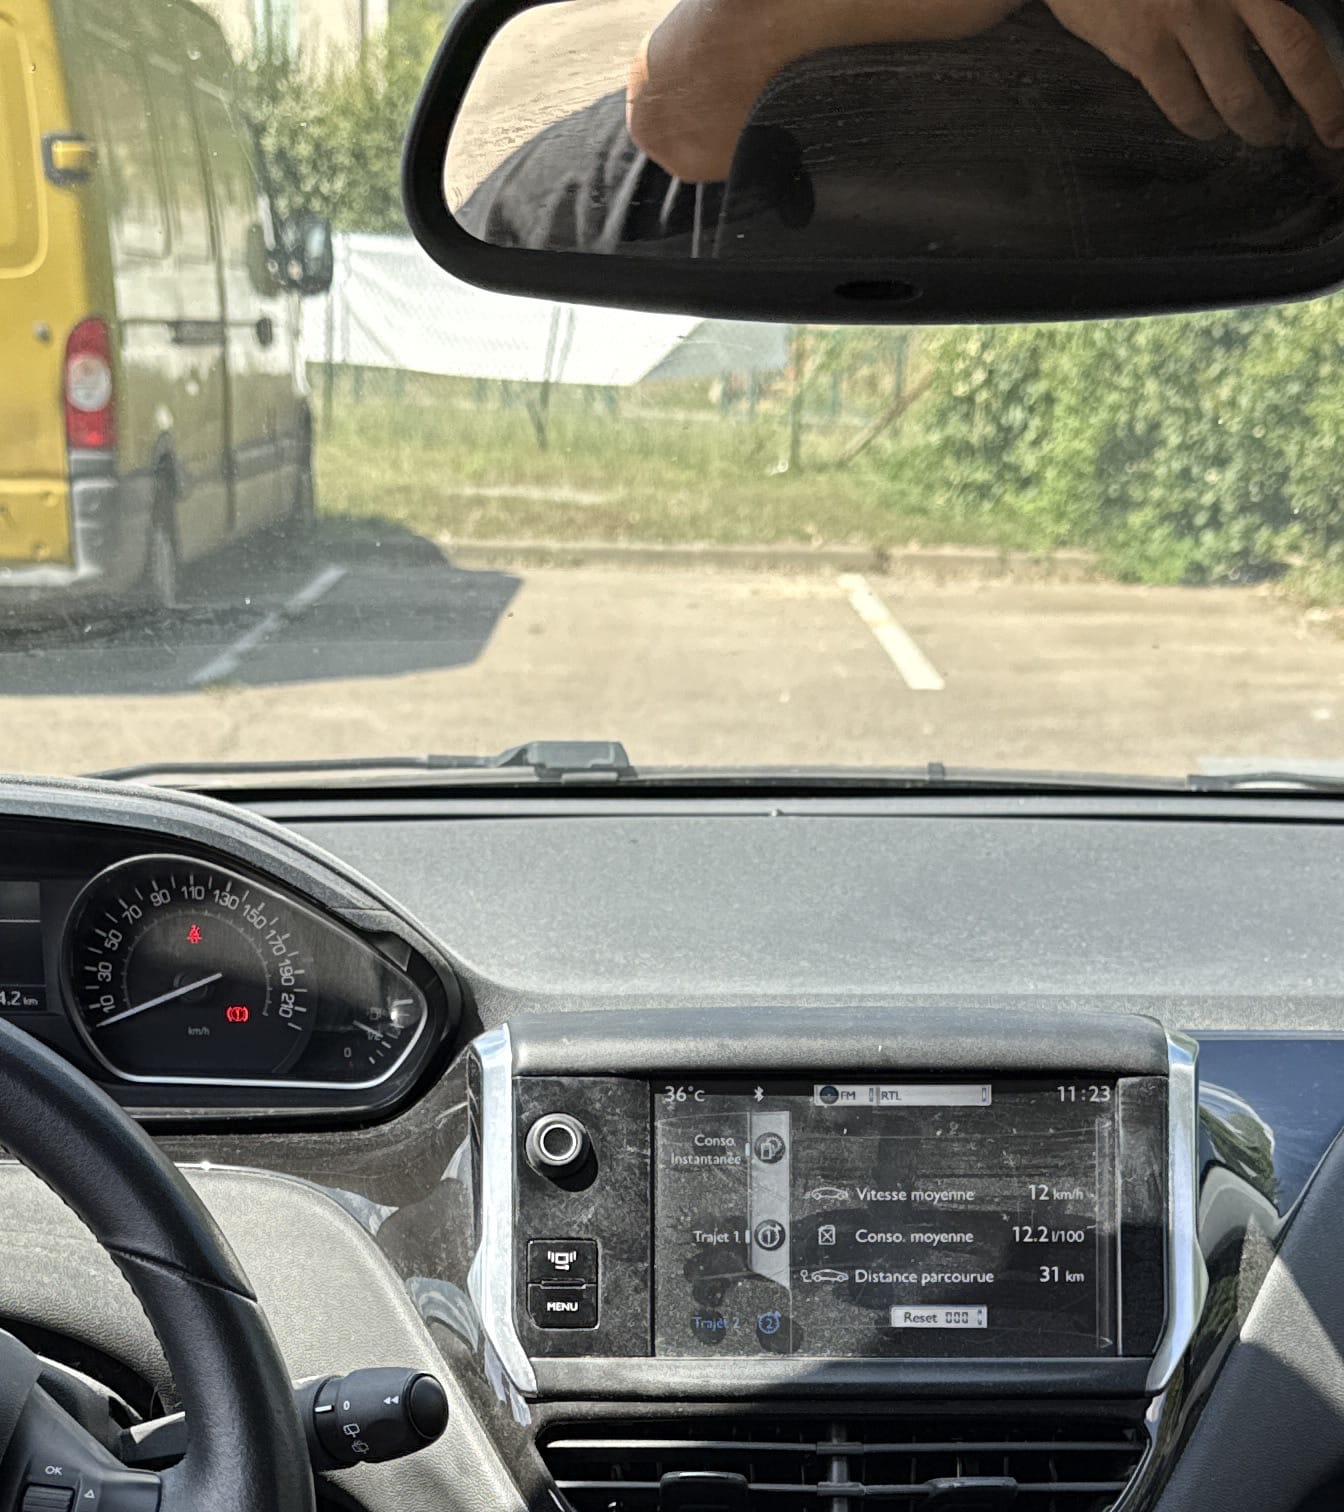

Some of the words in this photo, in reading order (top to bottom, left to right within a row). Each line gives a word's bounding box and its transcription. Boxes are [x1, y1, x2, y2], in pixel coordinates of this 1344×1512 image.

[150, 889, 171, 907] 90
[181, 886, 205, 900] 110
[213, 889, 239, 909] 130
[122, 904, 143, 924] 70
[242, 904, 267, 930] 150
[105, 929, 123, 950] 50
[265, 929, 286, 956] 170
[97, 961, 113, 982] 30
[278, 959, 295, 986] 190
[23, 997, 39, 1006] km
[99, 994, 116, 1013] 10
[278, 993, 296, 1019] 210
[187, 1026, 210, 1037] km/h
[840, 1090, 856, 1101] FM
[880, 1090, 902, 1101] RTL
[1056, 1085, 1111, 1103] 11:23
[855, 1187, 906, 1202] Vitesse
[911, 1190, 976, 1205] moyenne
[1028, 1184, 1050, 1201] 12
[1053, 1187, 1084, 1201] km/h
[692, 1230, 730, 1246] Trajet
[855, 1228, 906, 1243] Conso.
[910, 1232, 975, 1247] moyenne
[1012, 1226, 1049, 1243] 12.2
[854, 1269, 918, 1284] Distance
[921, 1273, 995, 1287] parcourue
[1039, 1265, 1059, 1283] 31
[1065, 1270, 1085, 1283] km
[546, 1301, 579, 1312] MENU
[903, 1311, 938, 1324] Reset
[343, 1400, 351, 1411] 0
[44, 1465, 63, 1476] OK
